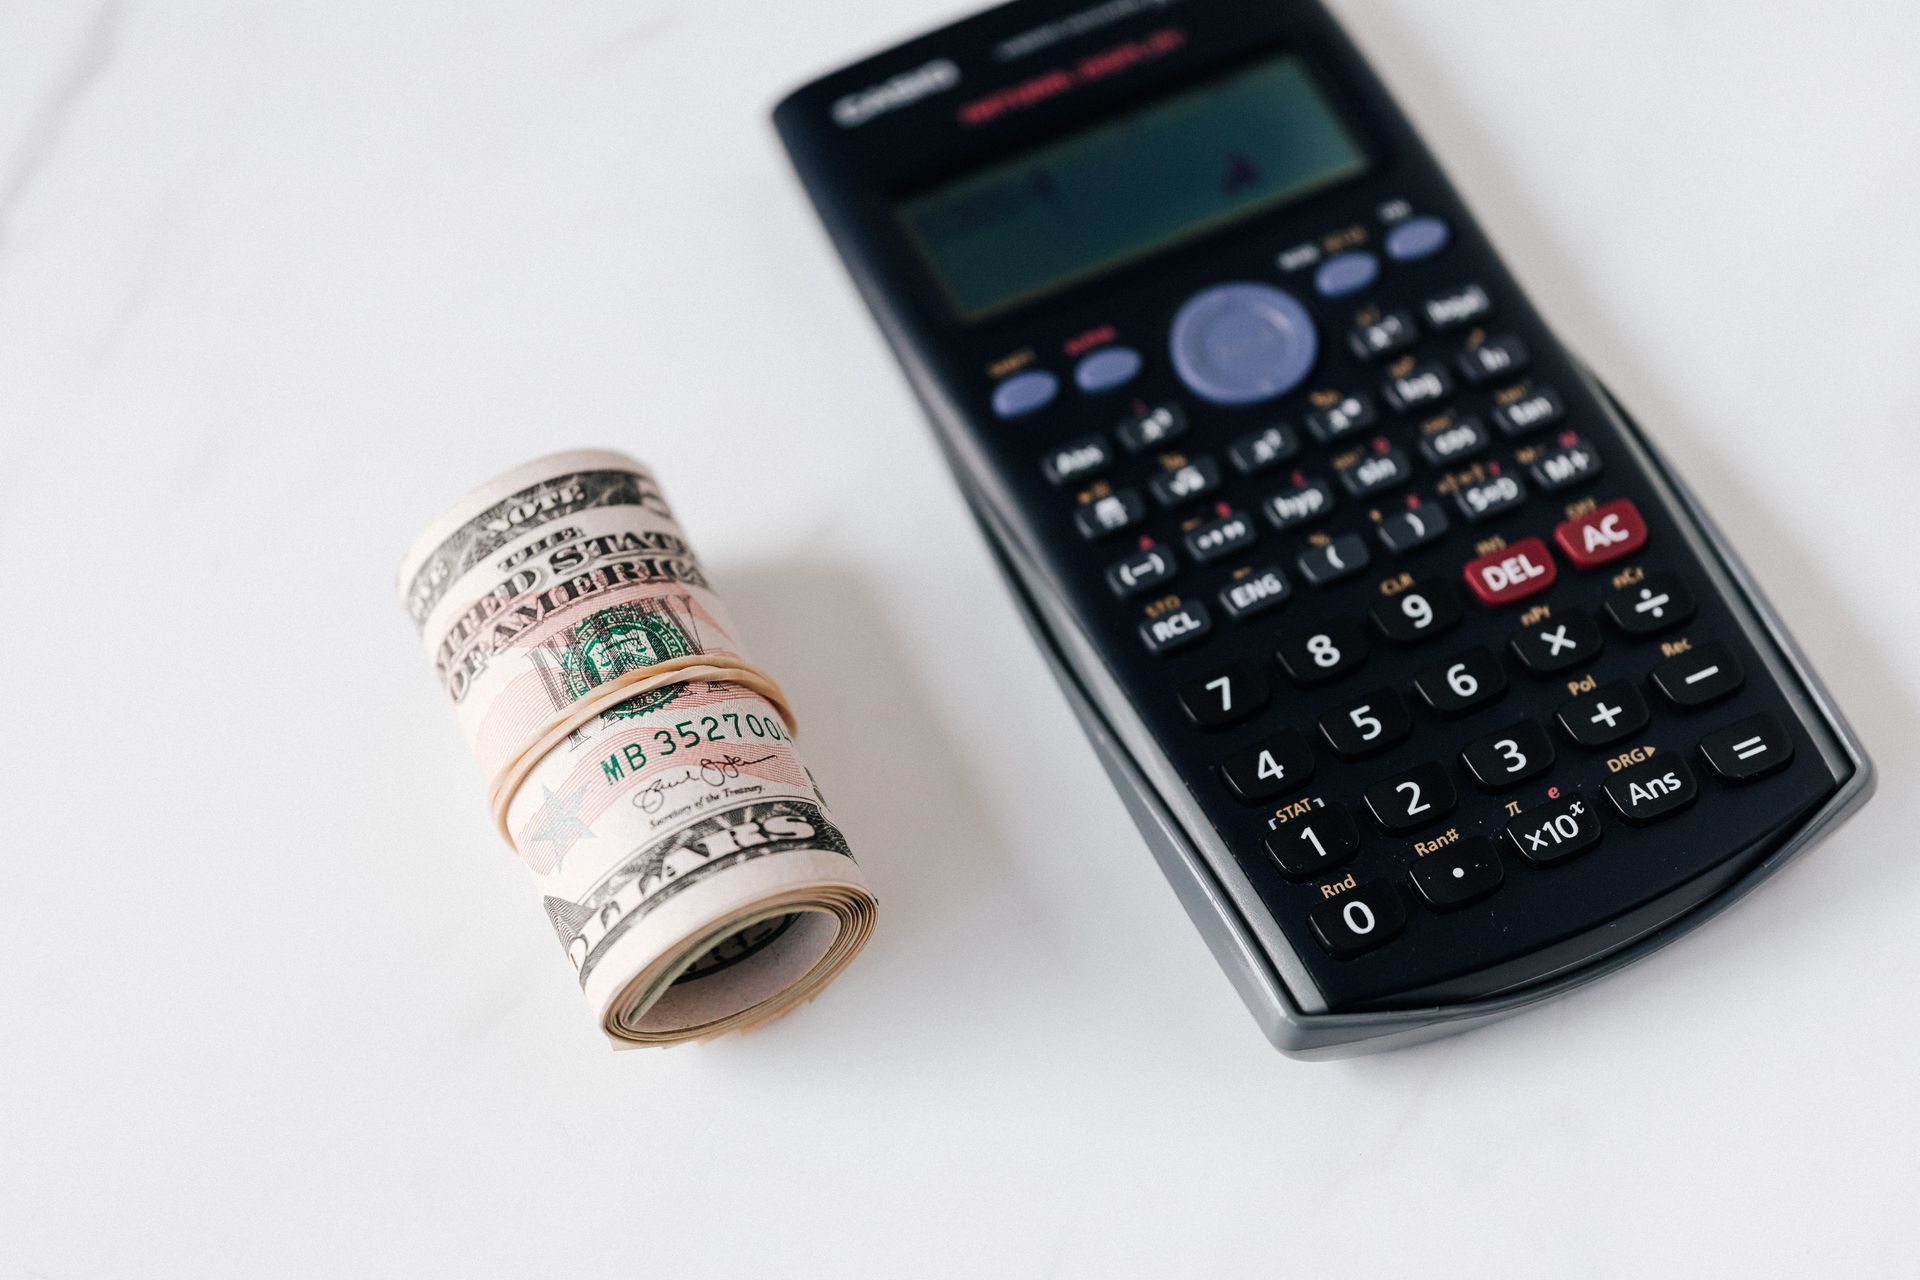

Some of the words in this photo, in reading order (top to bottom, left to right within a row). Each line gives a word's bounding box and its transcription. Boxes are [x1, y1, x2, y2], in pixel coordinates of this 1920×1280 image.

[497, 526, 584, 571] THE
[1582, 513, 1630, 554] AC
[1230, 572, 1284, 609] ENG
[1481, 553, 1546, 593] DEL
[1151, 611, 1203, 643] RCL
[1401, 594, 1434, 629] 9
[1307, 633, 1341, 668] 8
[1661, 637, 1693, 659] Rec
[1205, 675, 1232, 712] 7
[1446, 662, 1479, 698] 6
[1566, 674, 1598, 697] Pol
[1349, 704, 1383, 741] 5
[600, 743, 647, 785] MB
[653, 712, 793, 756] 352700
[1257, 749, 1285, 781] 4
[1493, 738, 1528, 774] 3
[1395, 780, 1432, 817] 2
[1547, 785, 1561, 799] e
[1628, 770, 1683, 807] Ans
[1300, 826, 1327, 858] 1
[1413, 827, 1461, 858] Ran#
[566, 814, 816, 972] OLLARS
[1320, 872, 1359, 900] Rnd
[1342, 900, 1377, 936] 0
